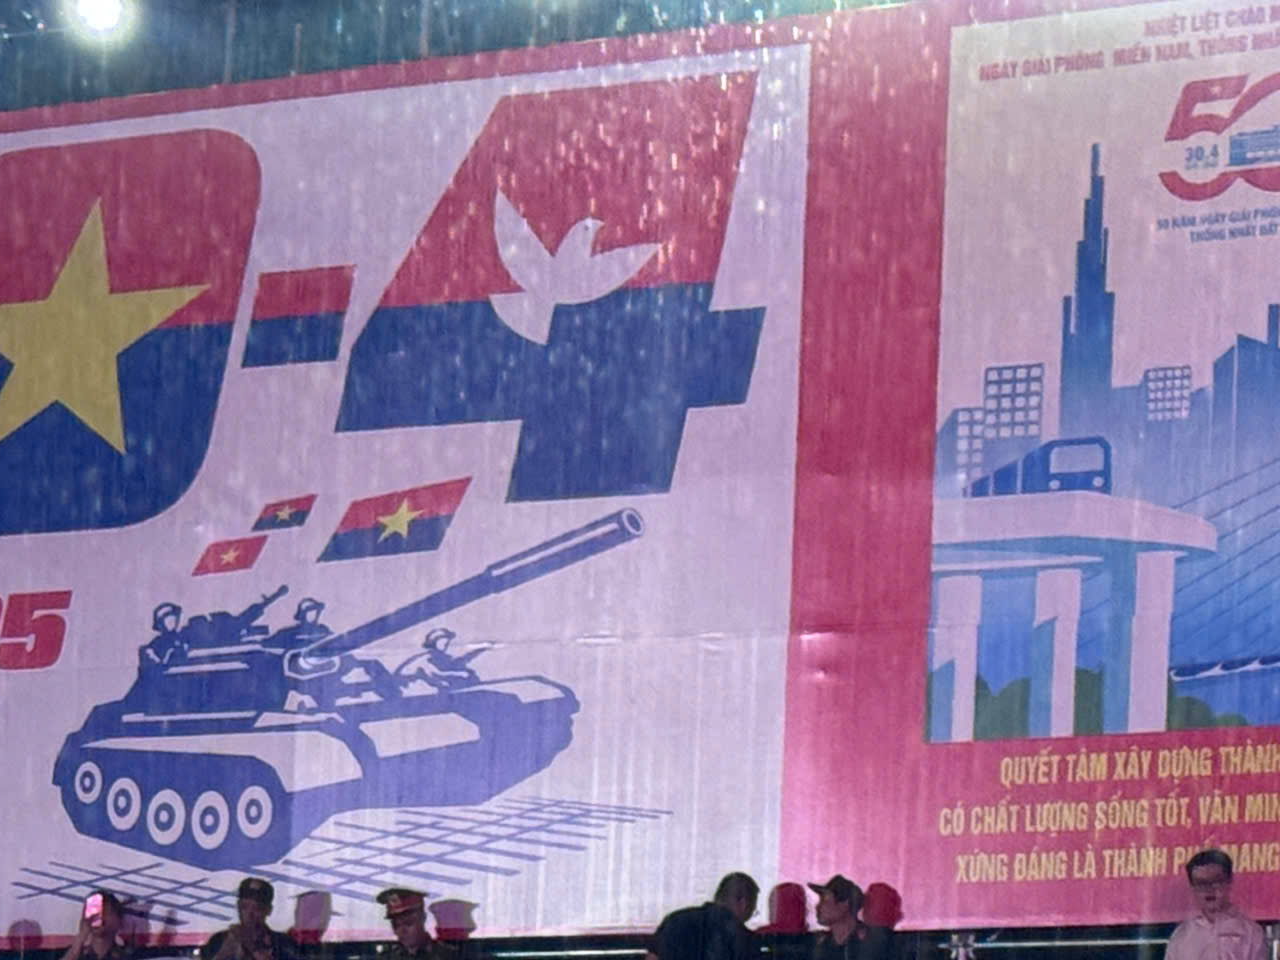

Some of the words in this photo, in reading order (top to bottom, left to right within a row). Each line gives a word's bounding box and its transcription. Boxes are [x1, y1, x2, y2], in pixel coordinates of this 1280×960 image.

[1000, 747, 1062, 788] QUYẾT
[1066, 747, 1108, 782] TÂM
[1113, 745, 1152, 780] XÂY
[1158, 745, 1212, 784] DỰNG
[939, 800, 965, 836] CÓ
[971, 795, 1019, 835] CHẤT
[1025, 800, 1088, 837] LƯỢNG
[1095, 790, 1148, 830] SỐNG
[1199, 789, 1239, 825] VĂN
[956, 848, 1008, 883] XỨNG
[1014, 845, 1067, 881] ĐÁNG
[1073, 843, 1096, 879] LÀ
[1103, 842, 1167, 878] THÀNH
